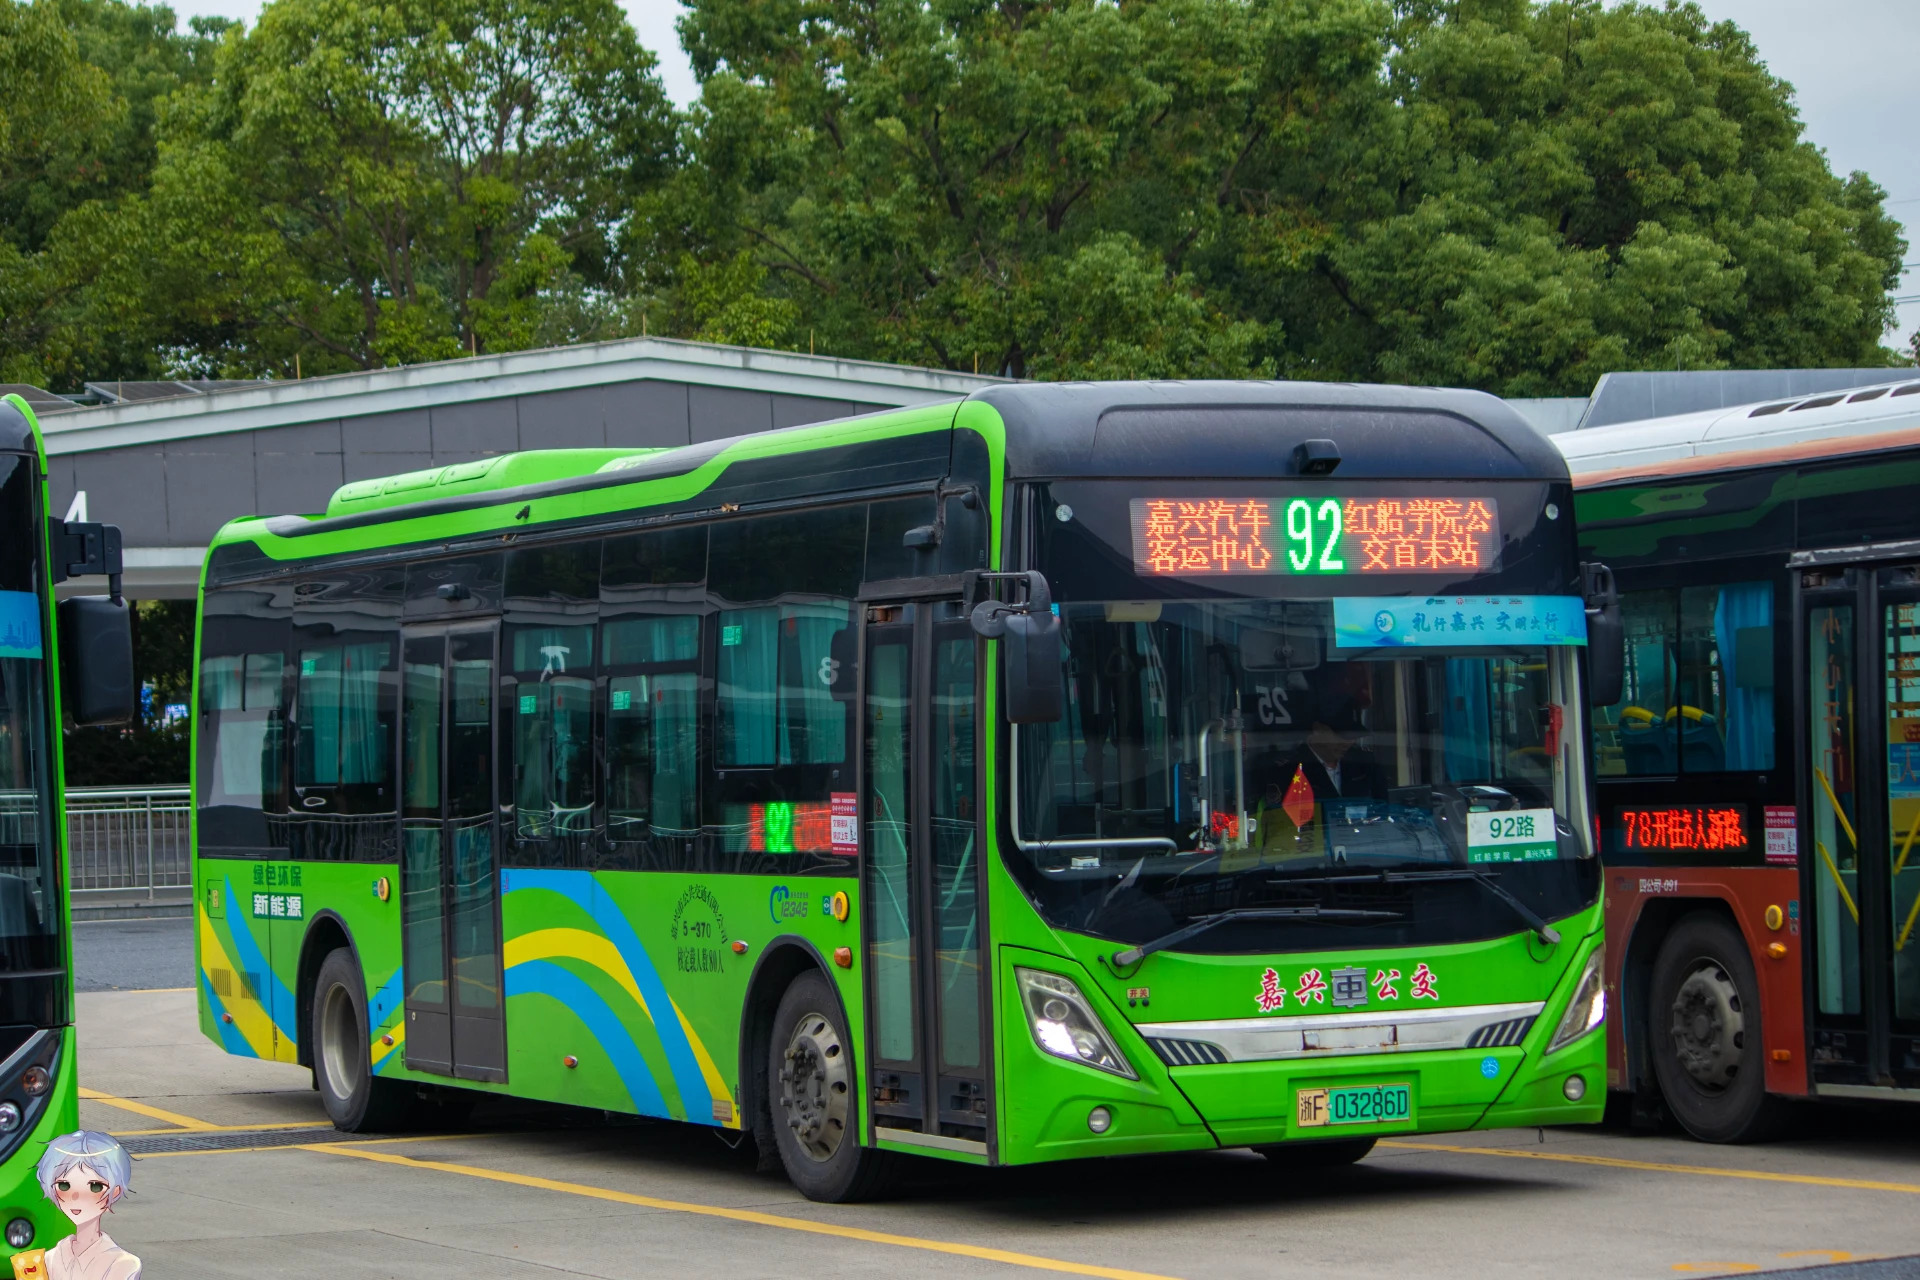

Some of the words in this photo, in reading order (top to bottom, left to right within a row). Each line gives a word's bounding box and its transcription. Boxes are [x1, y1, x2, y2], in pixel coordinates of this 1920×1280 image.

[1146, 501, 1271, 535] 嘉兴汽车
[1344, 500, 1492, 534] 红船学院公
[1287, 499, 1344, 571] 92
[1148, 536, 1272, 572] 客运中心
[1361, 535, 1479, 570] 交首末站
[1411, 610, 1485, 633] 礼行嘉兴
[1496, 610, 1560, 633] 文明出行
[1489, 815, 1535, 839] 92路
[253, 864, 302, 887] 绿色环保
[253, 893, 302, 918] 新能源
[781, 901, 809, 918] 12345
[1255, 967, 1327, 1012] 嘉兴
[1371, 963, 1439, 1000] 公交
